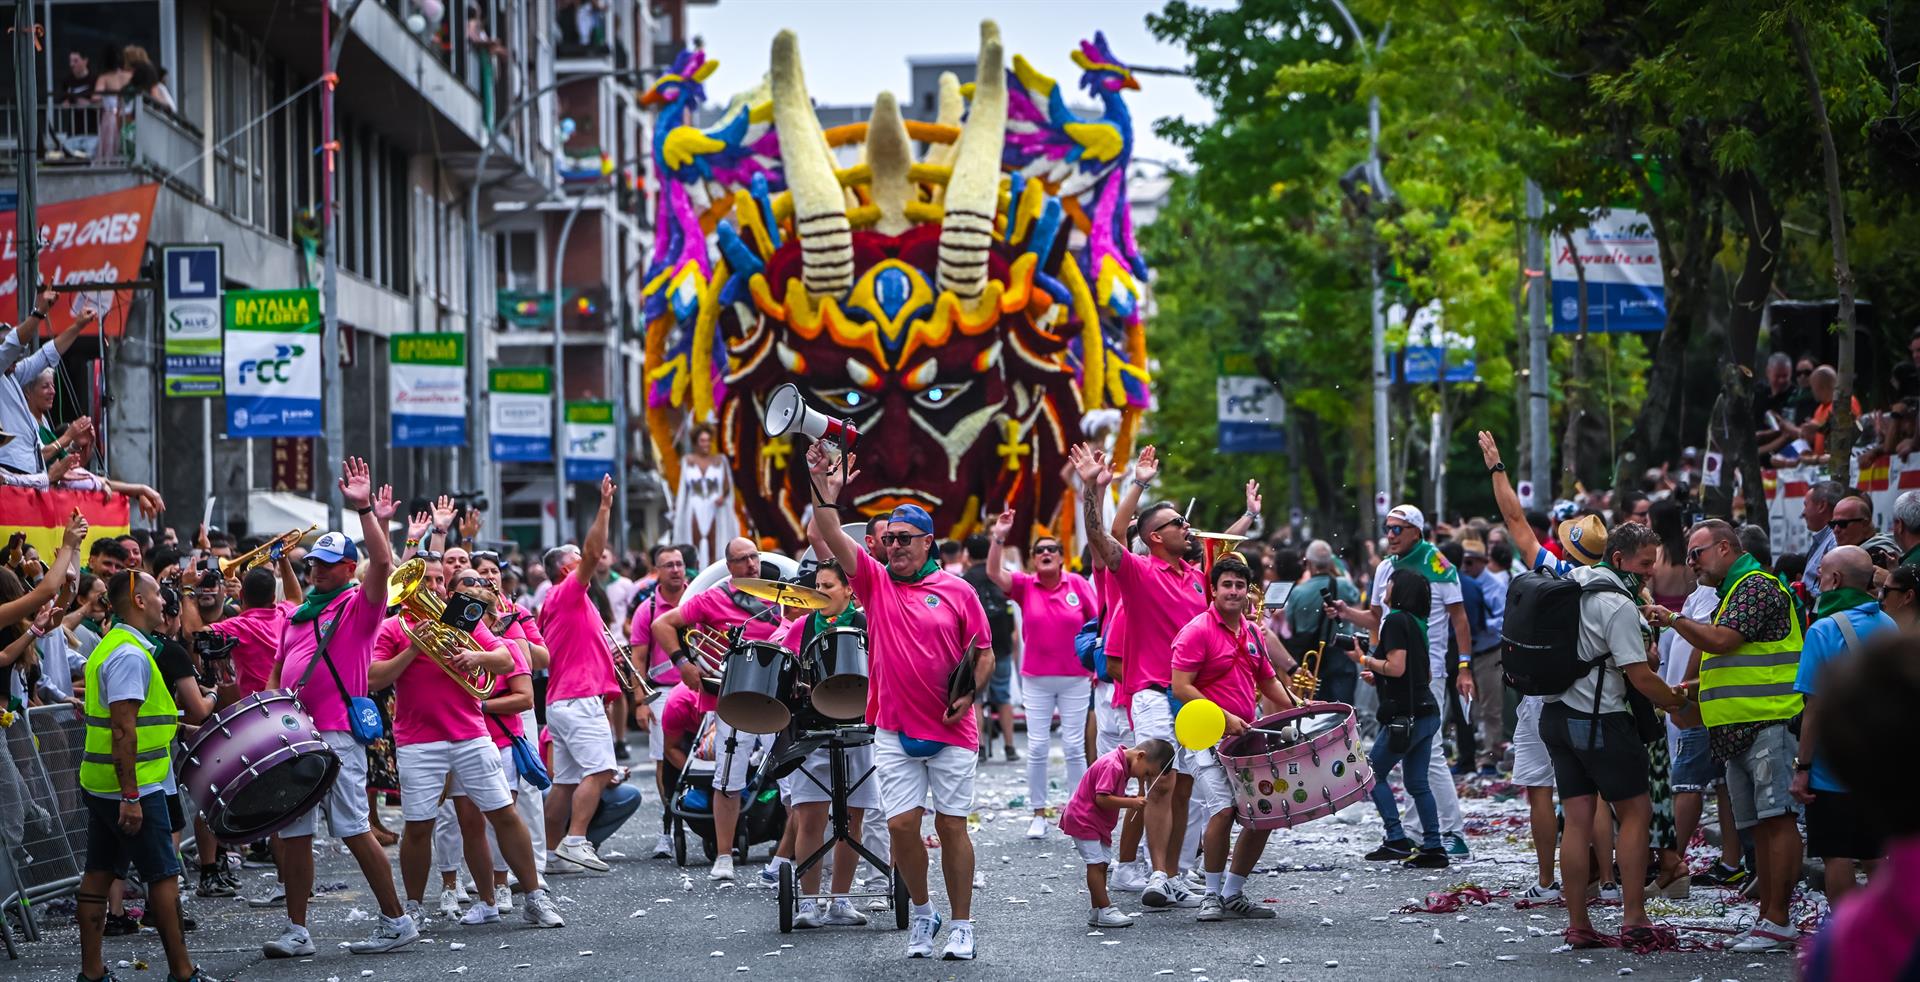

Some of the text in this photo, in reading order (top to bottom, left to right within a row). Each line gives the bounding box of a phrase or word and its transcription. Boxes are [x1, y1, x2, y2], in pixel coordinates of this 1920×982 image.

[2, 212, 141, 261] LS FLORES
[52, 260, 119, 286] Laredo
[179, 257, 205, 293] L
[235, 298, 309, 313] BATALLA
[239, 359, 292, 385] FCC
